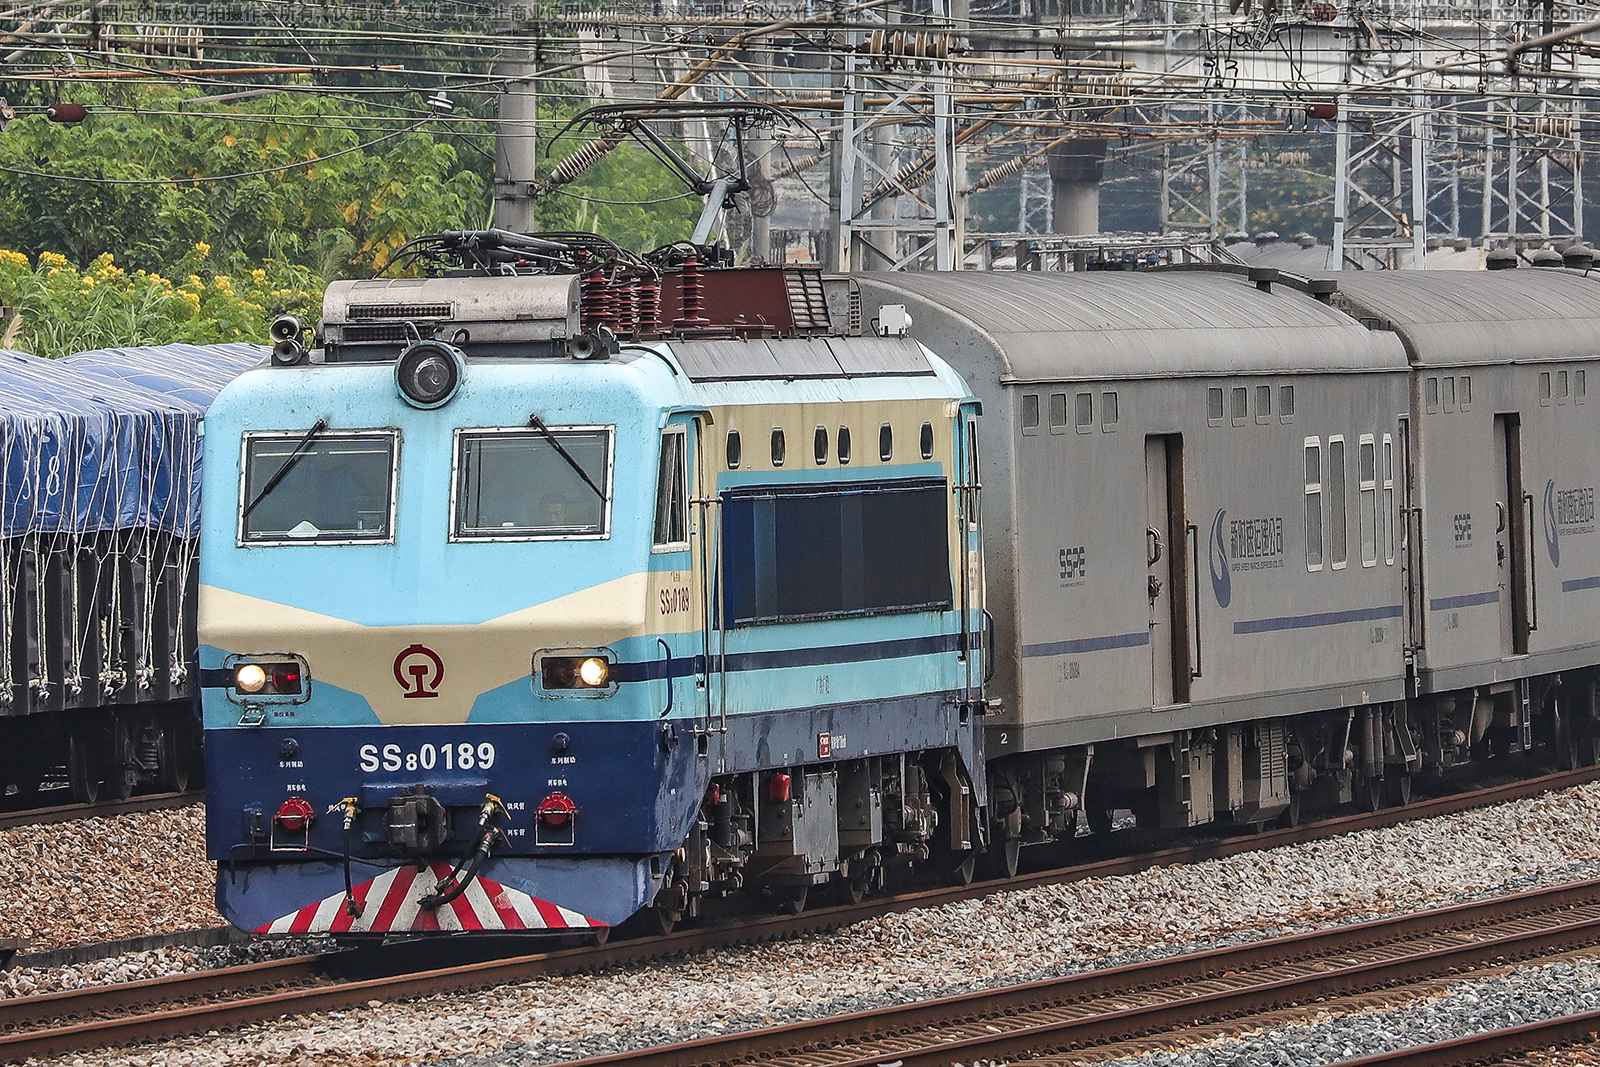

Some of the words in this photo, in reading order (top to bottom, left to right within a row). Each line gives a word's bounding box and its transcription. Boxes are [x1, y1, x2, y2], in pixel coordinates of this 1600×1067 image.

[46, 456, 60, 496] 8
[1059, 546, 1086, 579] SSPE
[1000, 732, 1008, 744] 2
[359, 742, 496, 773] SS80189
